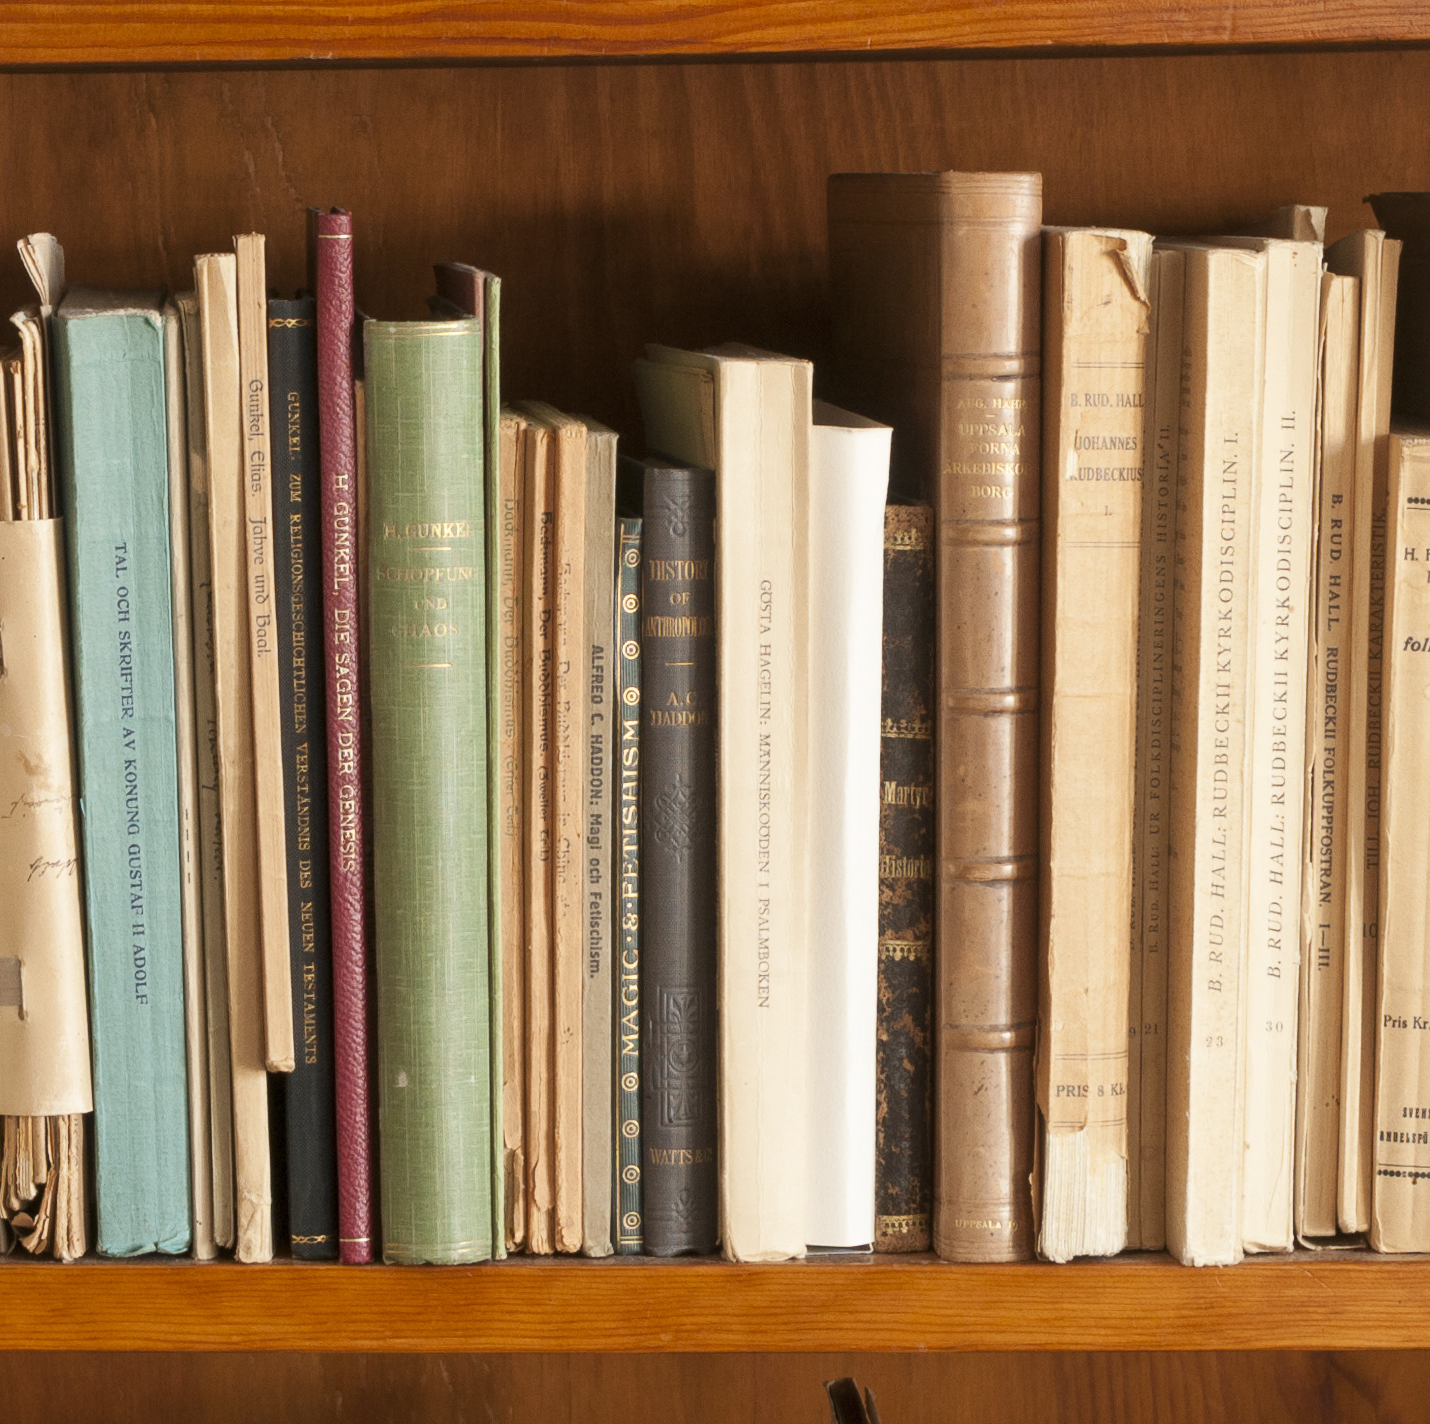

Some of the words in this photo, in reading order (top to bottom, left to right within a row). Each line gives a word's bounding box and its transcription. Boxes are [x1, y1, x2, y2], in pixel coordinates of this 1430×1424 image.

[1076, 435, 1137, 451] JOHANNES
[333, 501, 352, 596] GUNKEL,
[117, 586, 129, 624] OCH
[335, 608, 350, 646] DIE
[118, 631, 134, 719] SKRIFTER
[336, 652, 353, 723] SAGEN
[336, 731, 354, 776] DER
[124, 759, 140, 834] KONUNG
[338, 784, 357, 873] GENESIS
[1321, 747, 1336, 907] FOLKUPPFOSTRAN.
[128, 845, 143, 917] GUSTAF
[133, 943, 148, 1006] ADOLF
[757, 898, 770, 1009] PSALMBOKEN
[621, 949, 639, 1056] MAGIC
[1383, 1015, 1407, 1029] Pris
